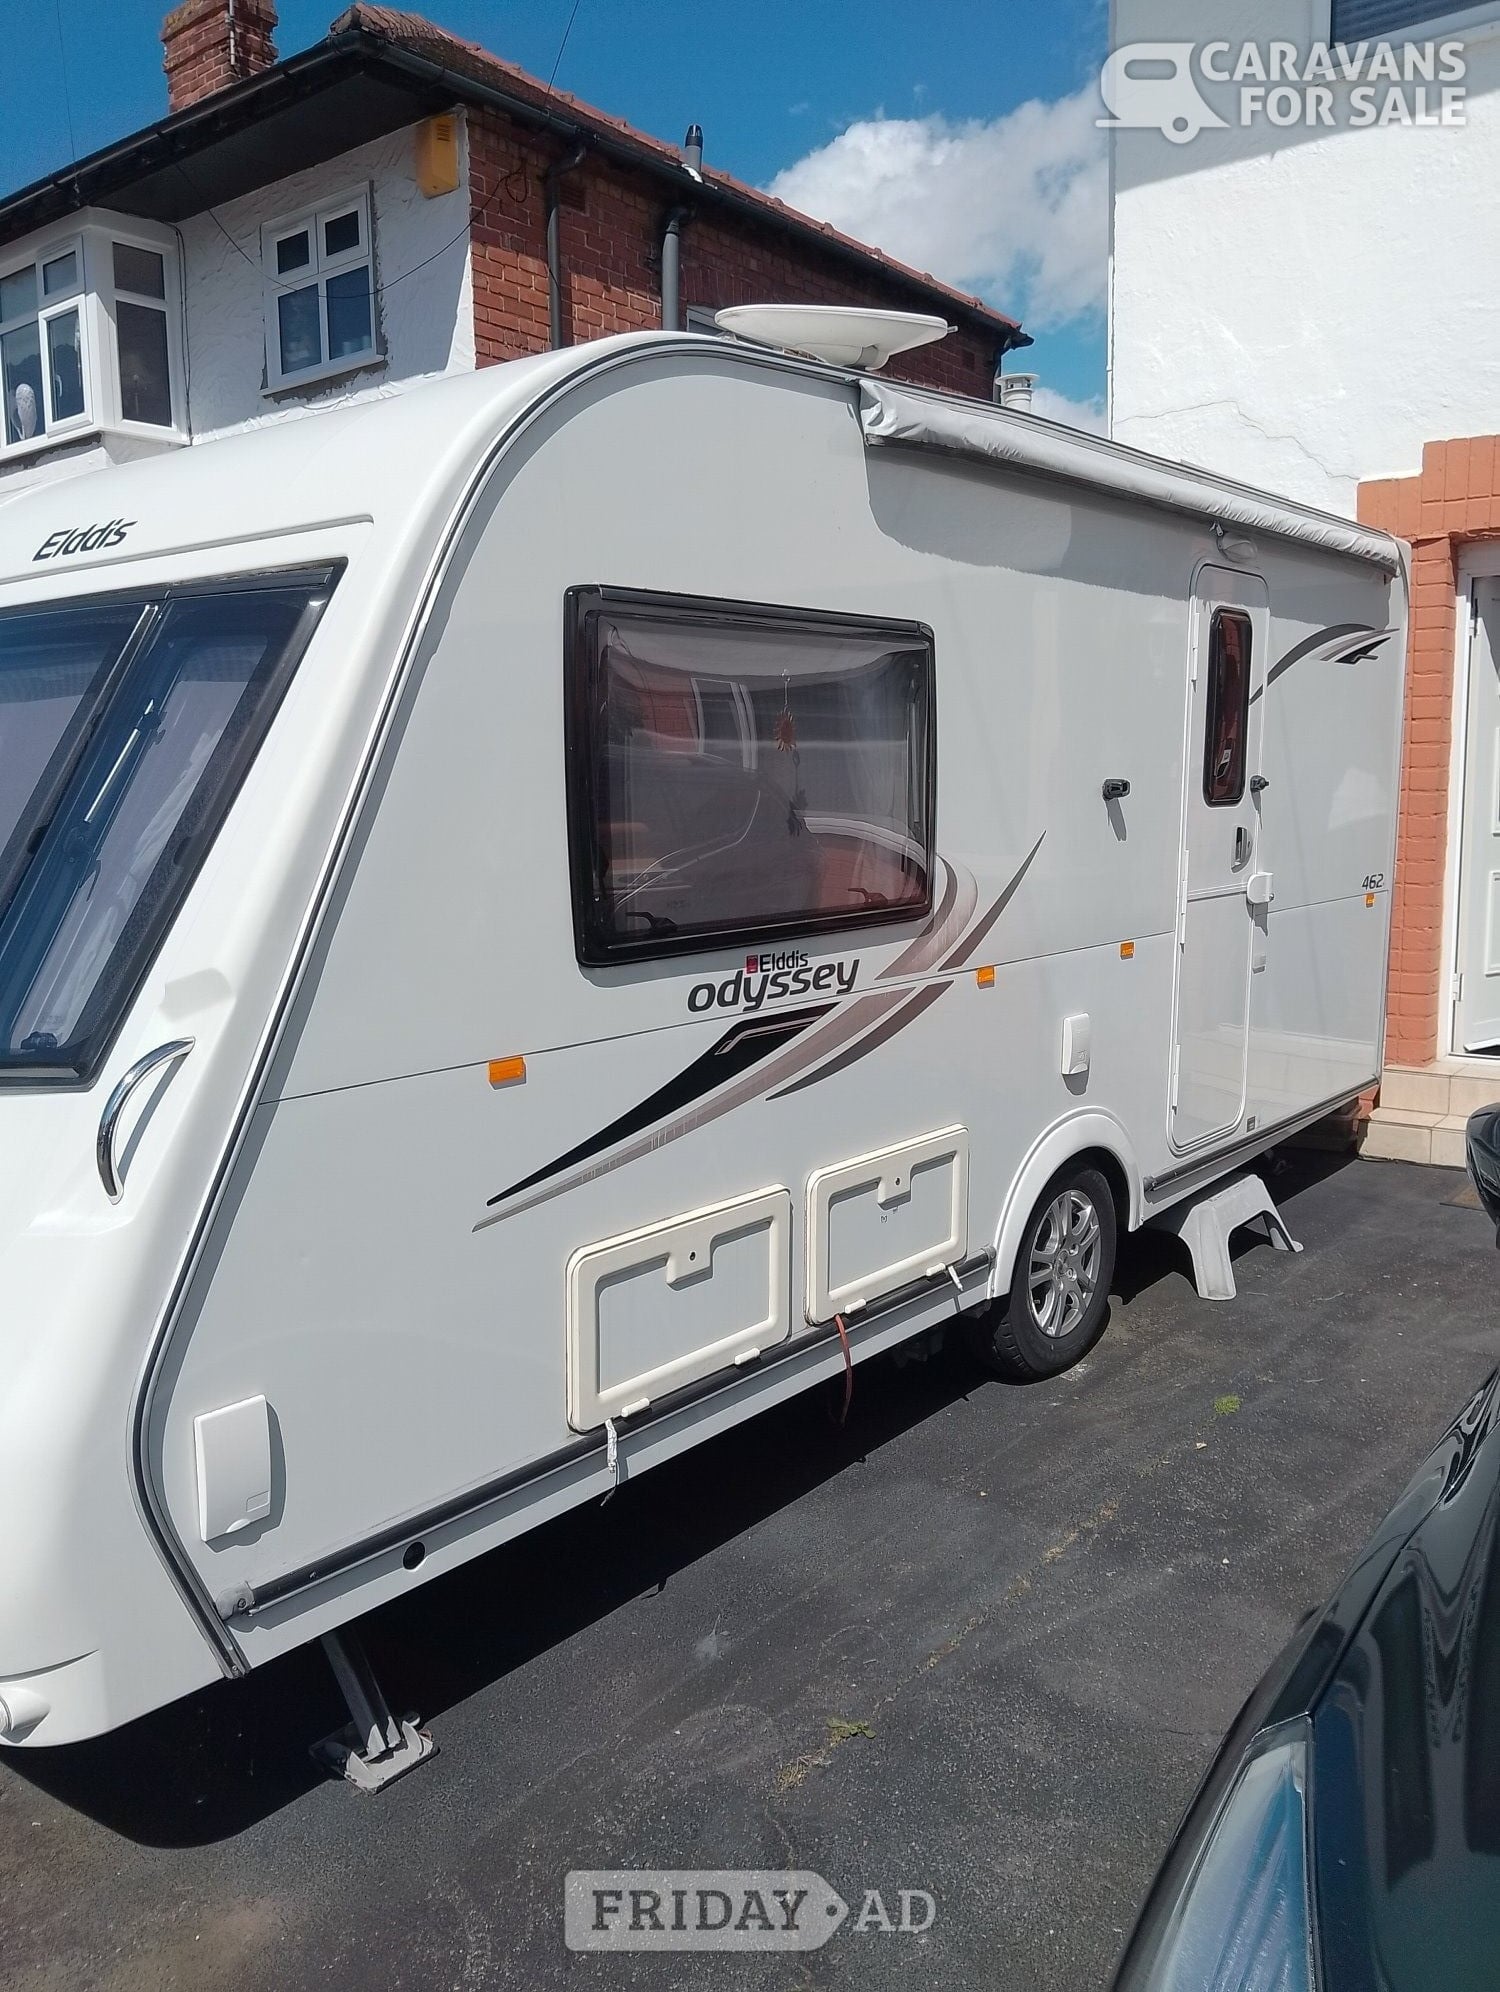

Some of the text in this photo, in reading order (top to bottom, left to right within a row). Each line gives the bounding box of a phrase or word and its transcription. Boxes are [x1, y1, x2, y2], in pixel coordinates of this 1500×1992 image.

[32, 518, 138, 561] Elddis
[1361, 873, 1384, 890] 462
[759, 951, 809, 973] Elddis
[687, 959, 861, 1013] odyssey
